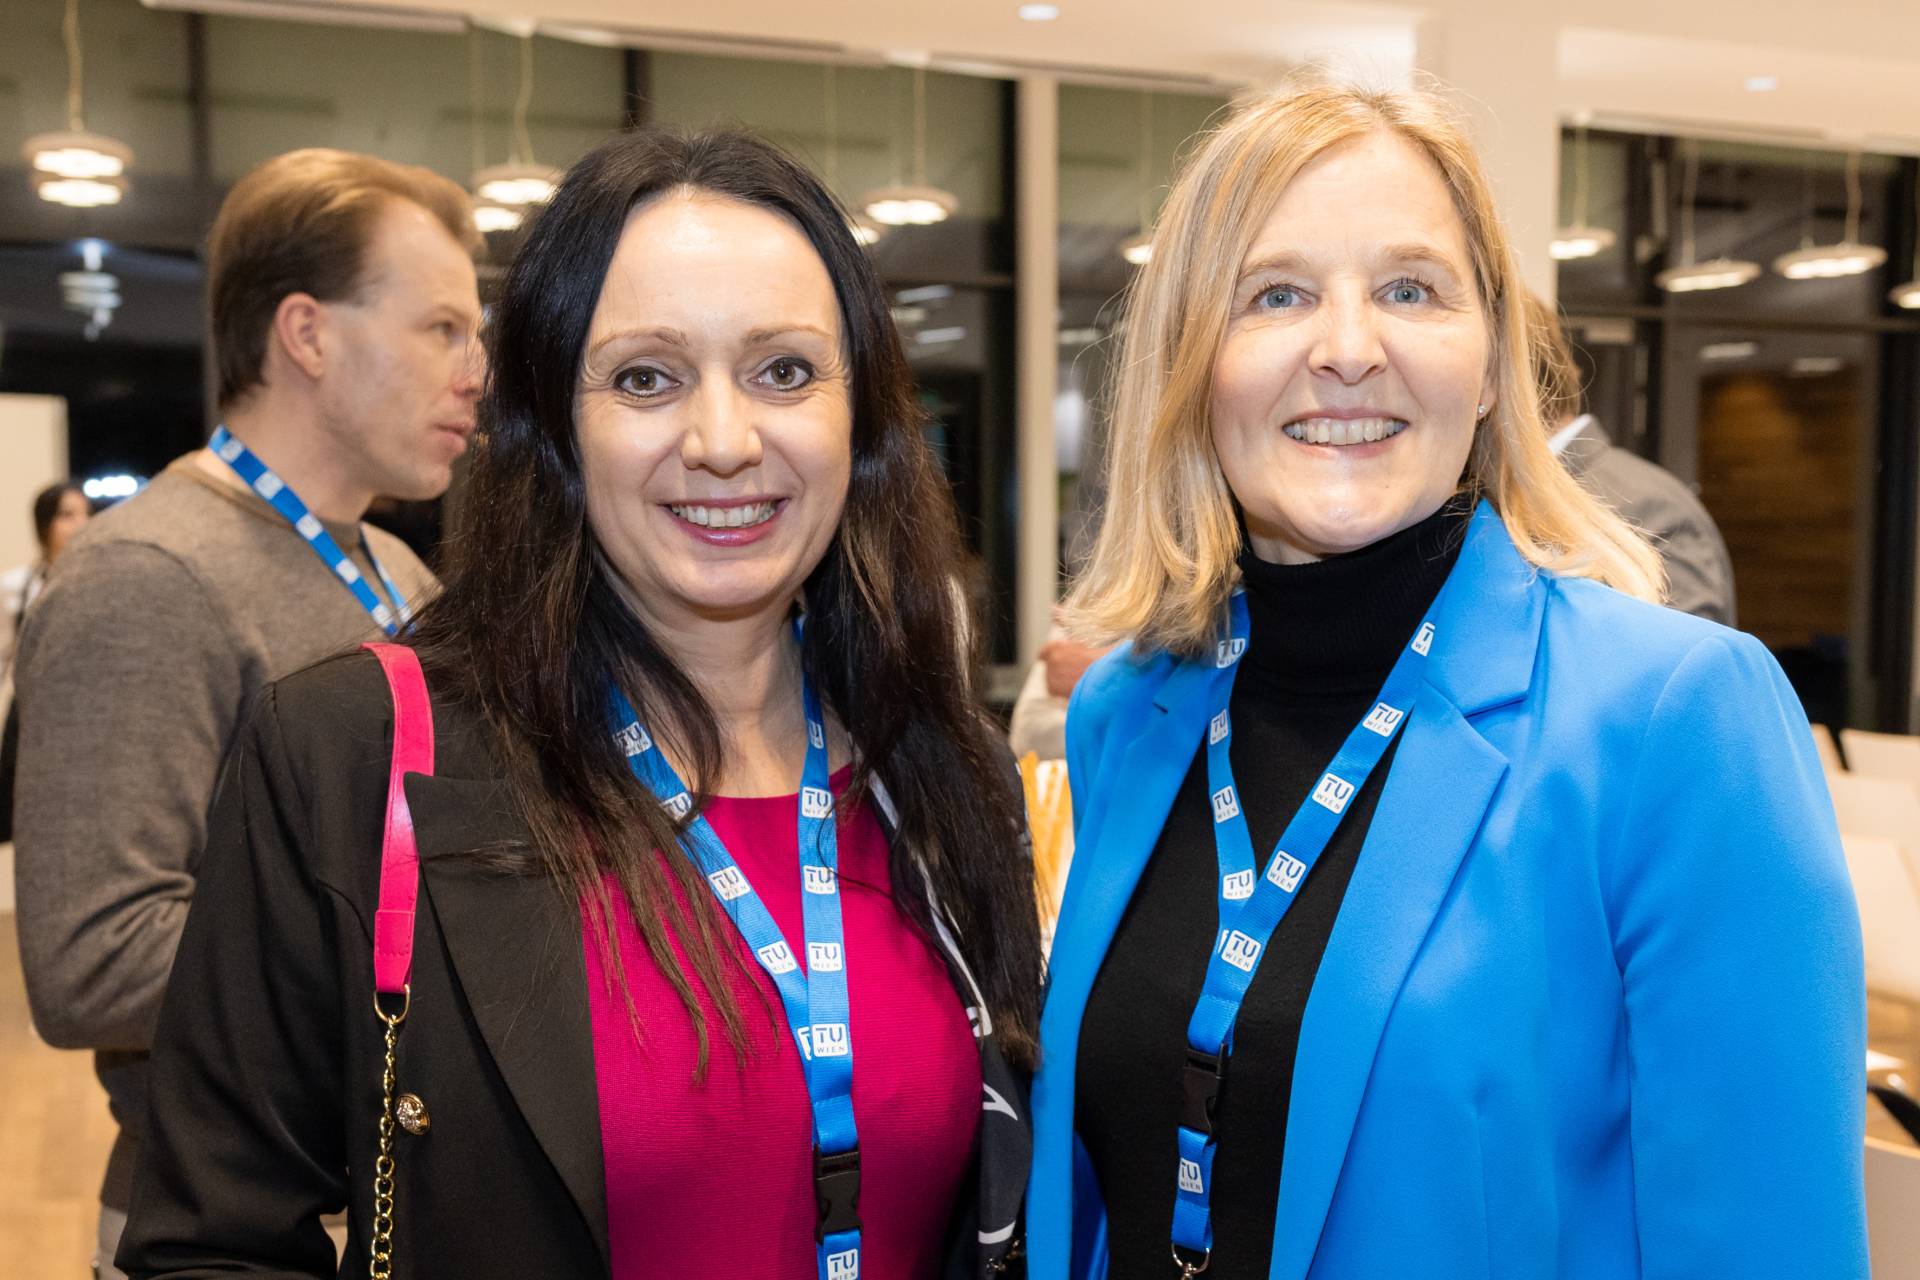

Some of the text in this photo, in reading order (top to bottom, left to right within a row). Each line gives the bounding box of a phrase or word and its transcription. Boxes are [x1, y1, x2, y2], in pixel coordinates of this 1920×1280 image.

[1220, 641, 1243, 656] TU
[1213, 711, 1226, 733] TU
[1375, 705, 1400, 724] TU
[1325, 776, 1350, 800] TU
[805, 790, 828, 807] TU
[1214, 789, 1233, 810] TU
[806, 868, 831, 883] TU
[1276, 854, 1302, 879] TU
[712, 869, 739, 888] TU
[1226, 872, 1250, 889] TU
[1270, 871, 1293, 888] WIEN
[760, 944, 787, 963] TU
[811, 945, 837, 960] TU
[1233, 934, 1257, 958] TU
[1225, 952, 1249, 968] WIEN
[815, 1027, 842, 1043] TU
[1181, 1161, 1198, 1180] TU
[830, 1252, 855, 1272] TU
